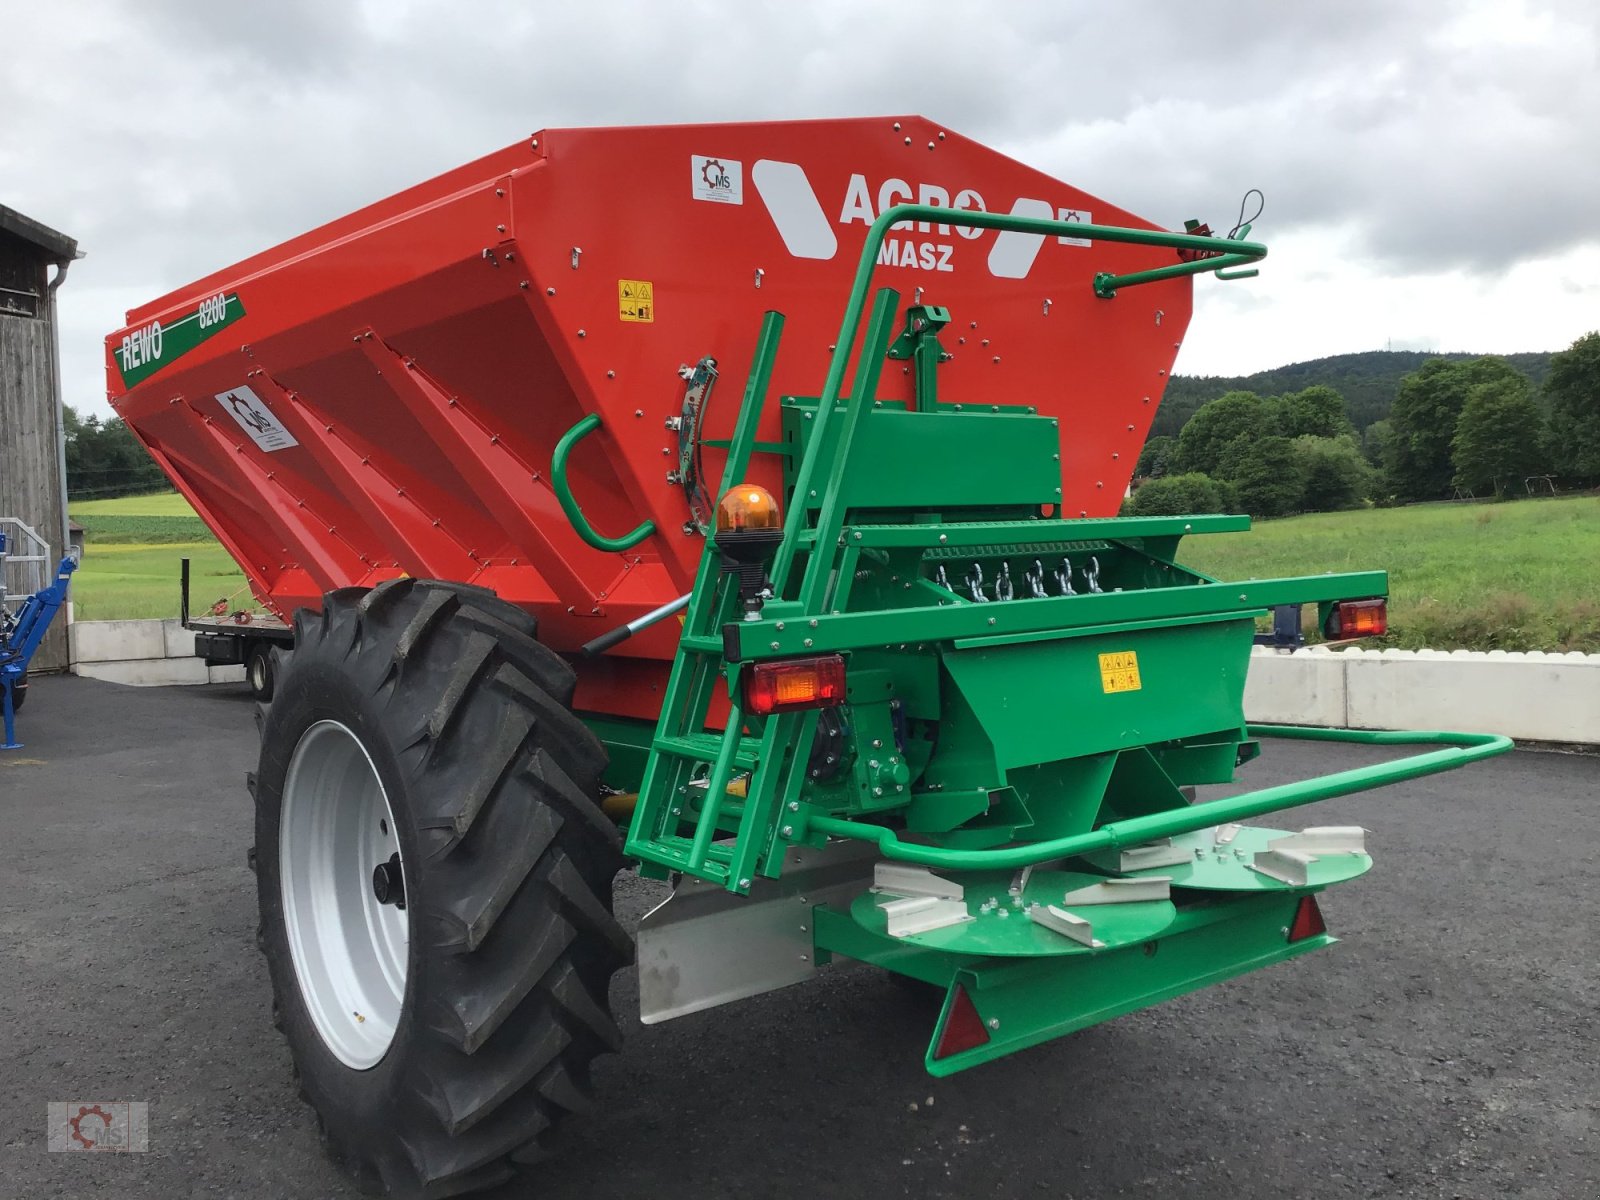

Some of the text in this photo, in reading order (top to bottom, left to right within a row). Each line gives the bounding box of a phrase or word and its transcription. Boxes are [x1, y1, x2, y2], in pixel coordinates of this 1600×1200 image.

[839, 173, 987, 240] AGRO
[876, 238, 954, 272] MASZ
[122, 292, 227, 373] REWO 8200
